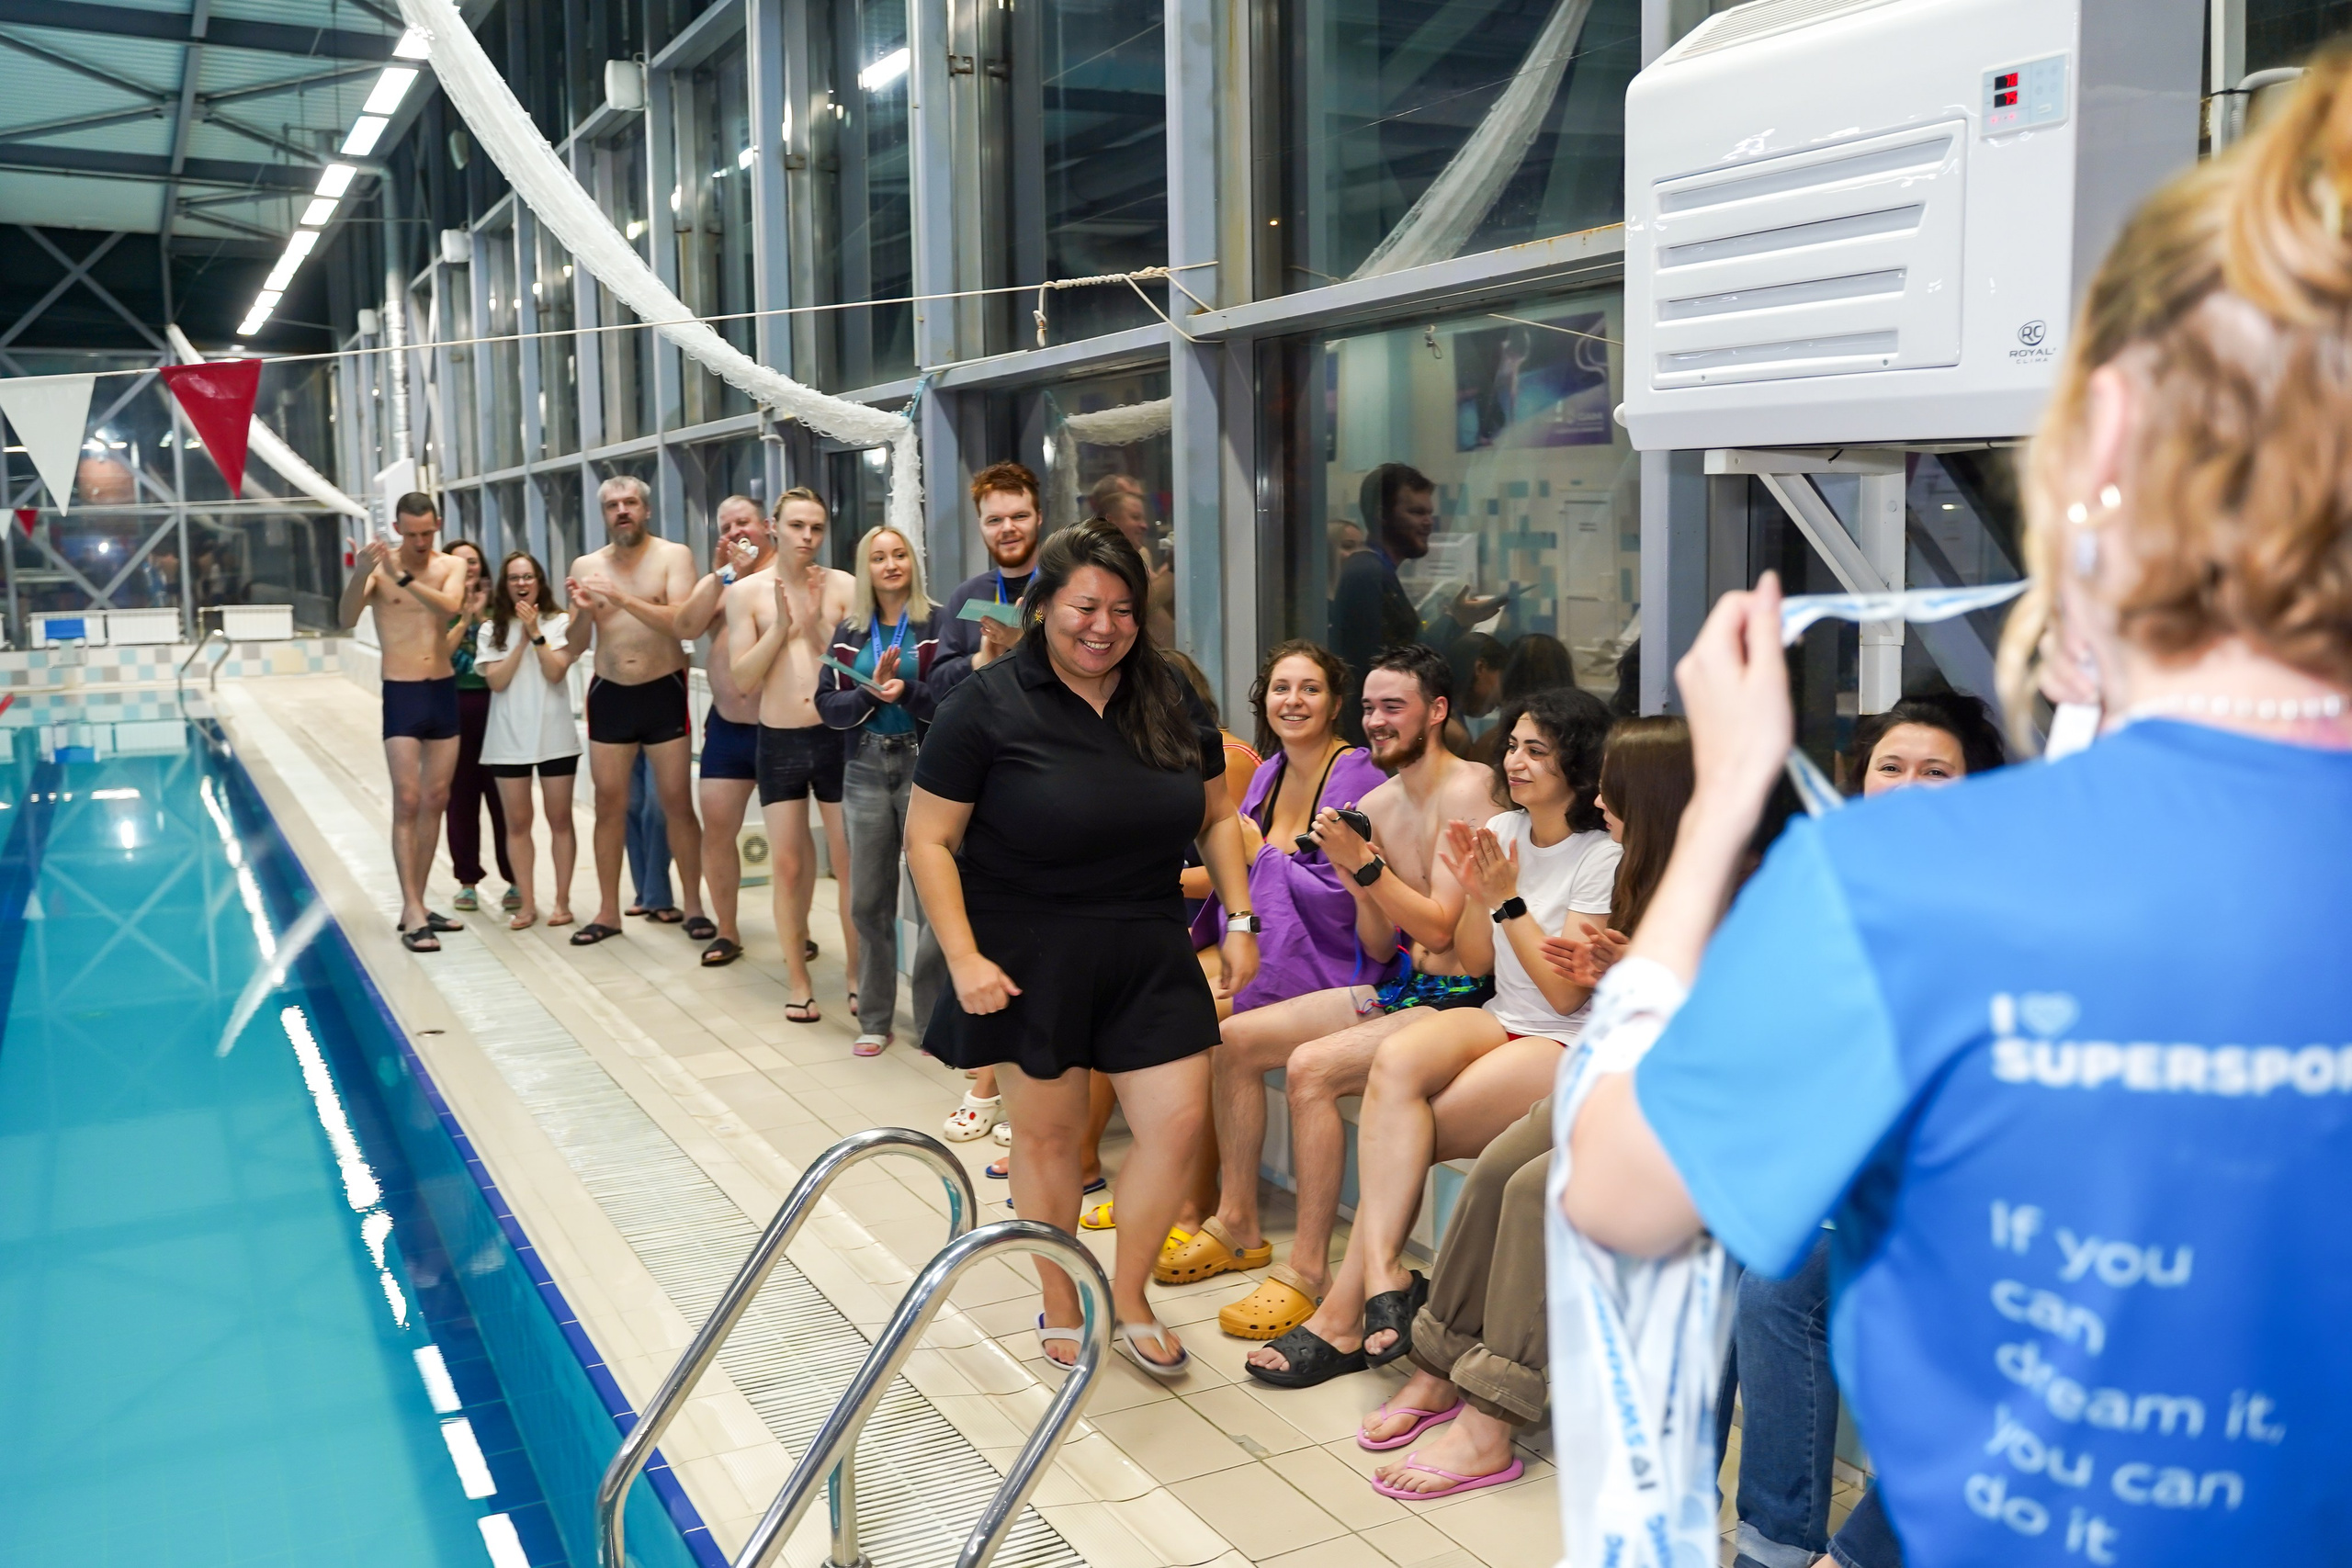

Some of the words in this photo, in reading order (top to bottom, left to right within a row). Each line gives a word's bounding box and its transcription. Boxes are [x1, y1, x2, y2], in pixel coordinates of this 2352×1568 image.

[2005, 90, 2018, 106] 75
[2009, 348, 2053, 357] ROYAL
[2022, 325, 2042, 341] RC
[1992, 993, 2016, 1035] I
[1990, 1199, 2044, 1256] If
[2056, 1227, 2193, 1287] you
[1991, 1280, 2105, 1356] can
[1995, 1341, 2205, 1438] dream
[2226, 1389, 2286, 1446] it,
[1984, 1404, 2094, 1489] you
[2112, 1462, 2243, 1511] can
[1965, 1473, 2049, 1536] do
[2067, 1507, 2118, 1564] it
